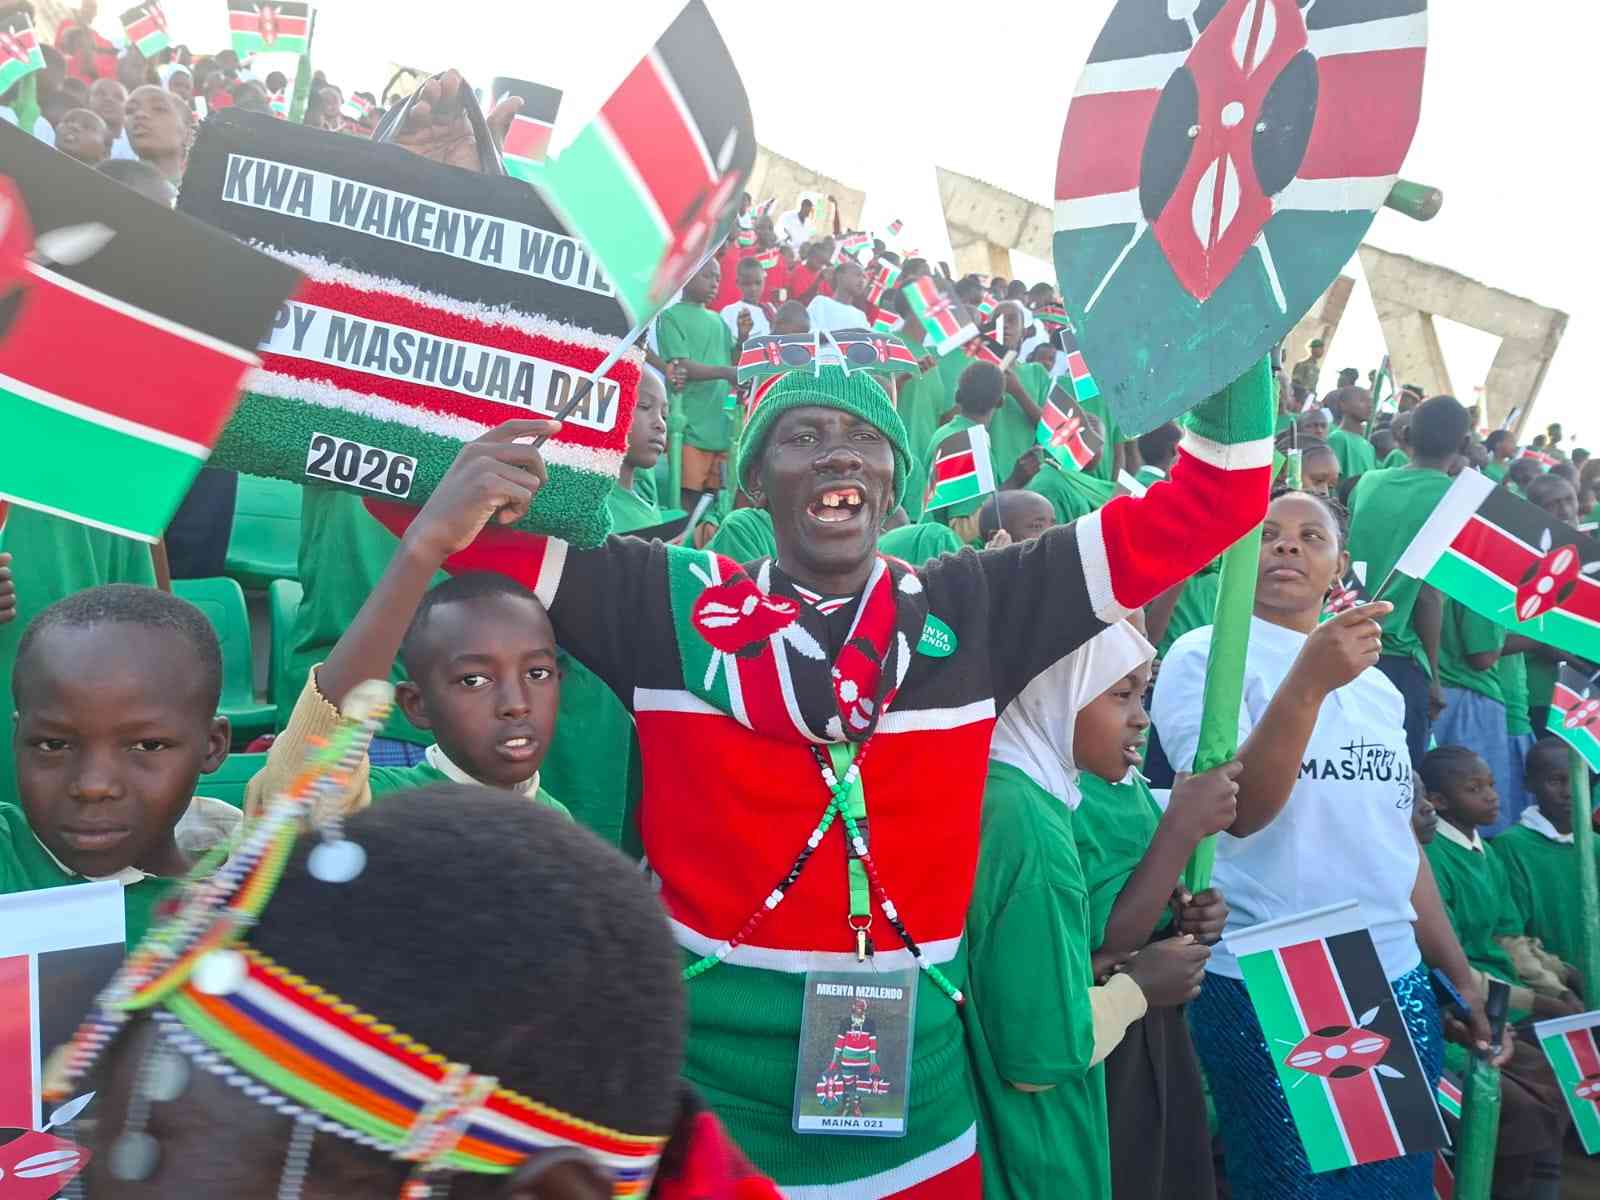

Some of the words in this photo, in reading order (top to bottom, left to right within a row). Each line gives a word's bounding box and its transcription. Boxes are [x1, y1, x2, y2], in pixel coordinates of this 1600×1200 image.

[223, 156, 315, 217] KWA
[329, 179, 506, 265] WAKENYA
[262, 303, 318, 352] PY
[323, 314, 537, 406] MASHUJAA
[544, 368, 617, 424] DAY
[305, 435, 413, 496] 2026
[920, 633, 951, 652] ENDO
[1340, 735, 1396, 776] Happy
[816, 983, 854, 997] MKENYA
[855, 985, 903, 1000] MZALENDO
[821, 1118, 860, 1128] MAINA
[863, 1119, 883, 1128] 021
